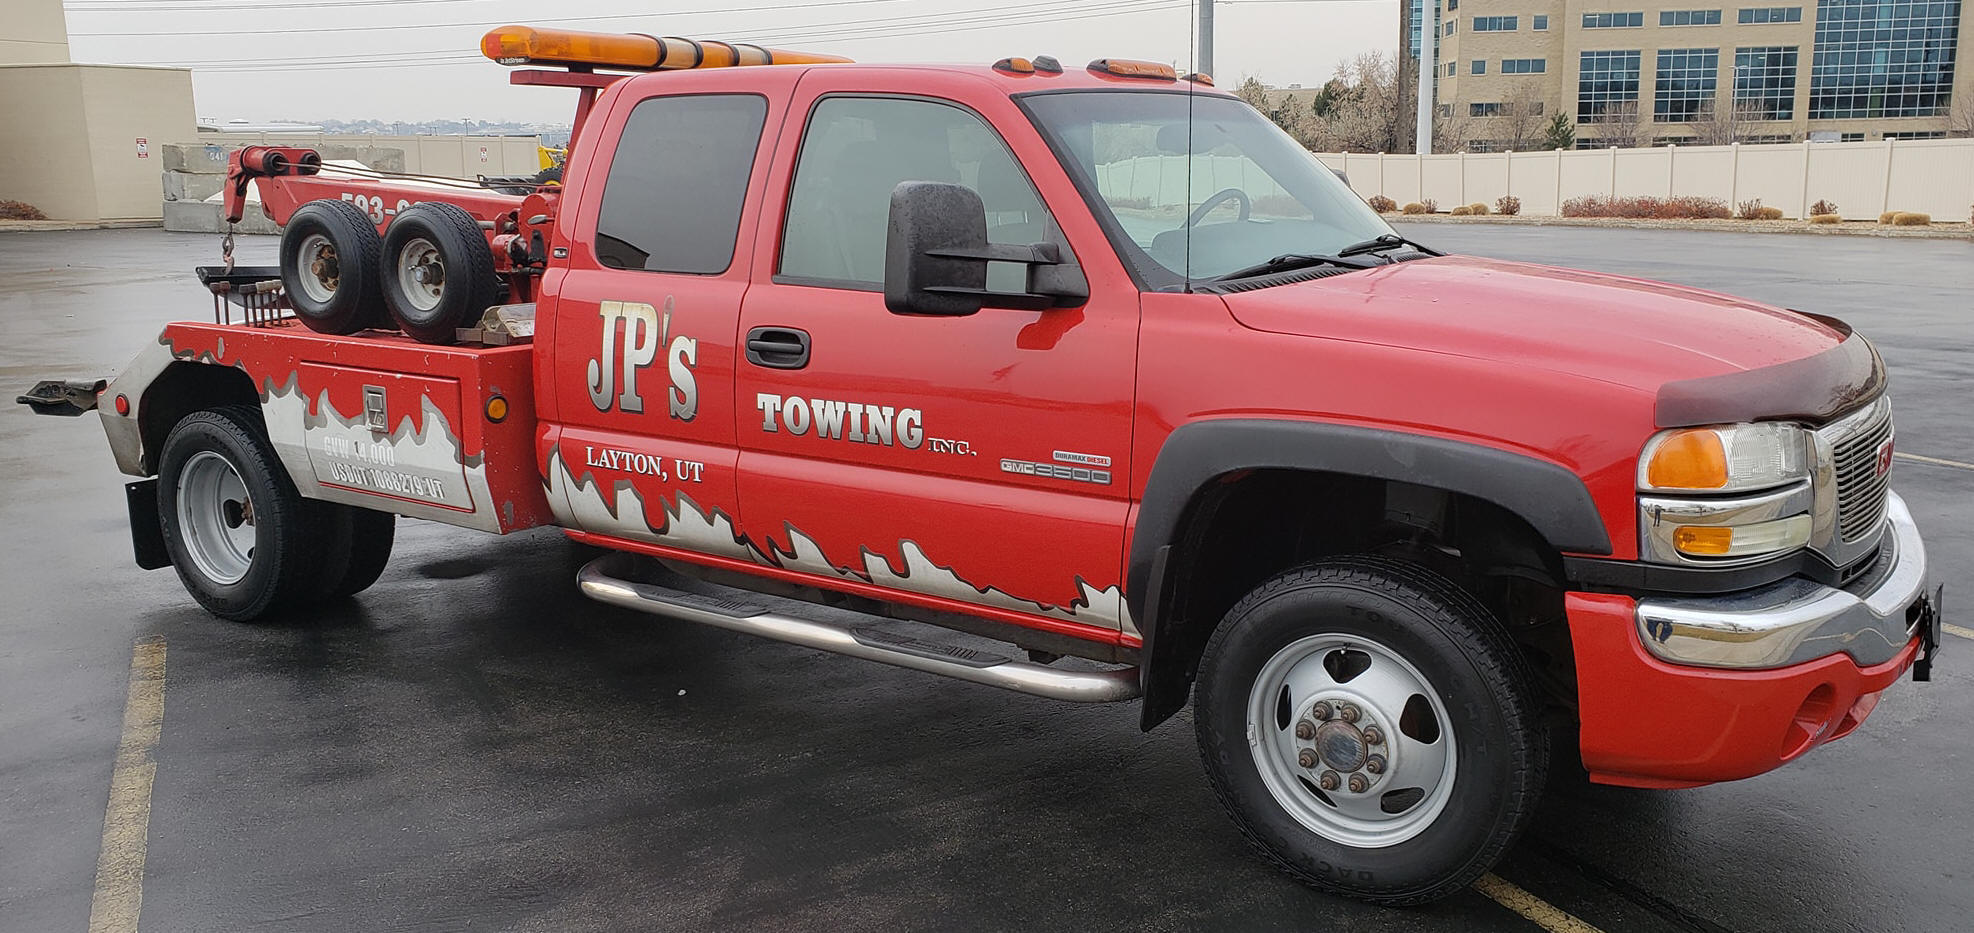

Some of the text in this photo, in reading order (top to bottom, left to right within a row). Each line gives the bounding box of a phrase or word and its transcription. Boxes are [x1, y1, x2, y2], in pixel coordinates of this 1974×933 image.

[586, 294, 699, 422] JP's
[756, 392, 978, 456] TOWING INC.
[324, 436, 395, 467] GVW 14,000
[586, 446, 705, 484] LAYTON, UT
[1055, 452, 1110, 465] DURAMAX DIESEL
[329, 462, 370, 486] USDOT
[370, 468, 424, 497] 1088279
